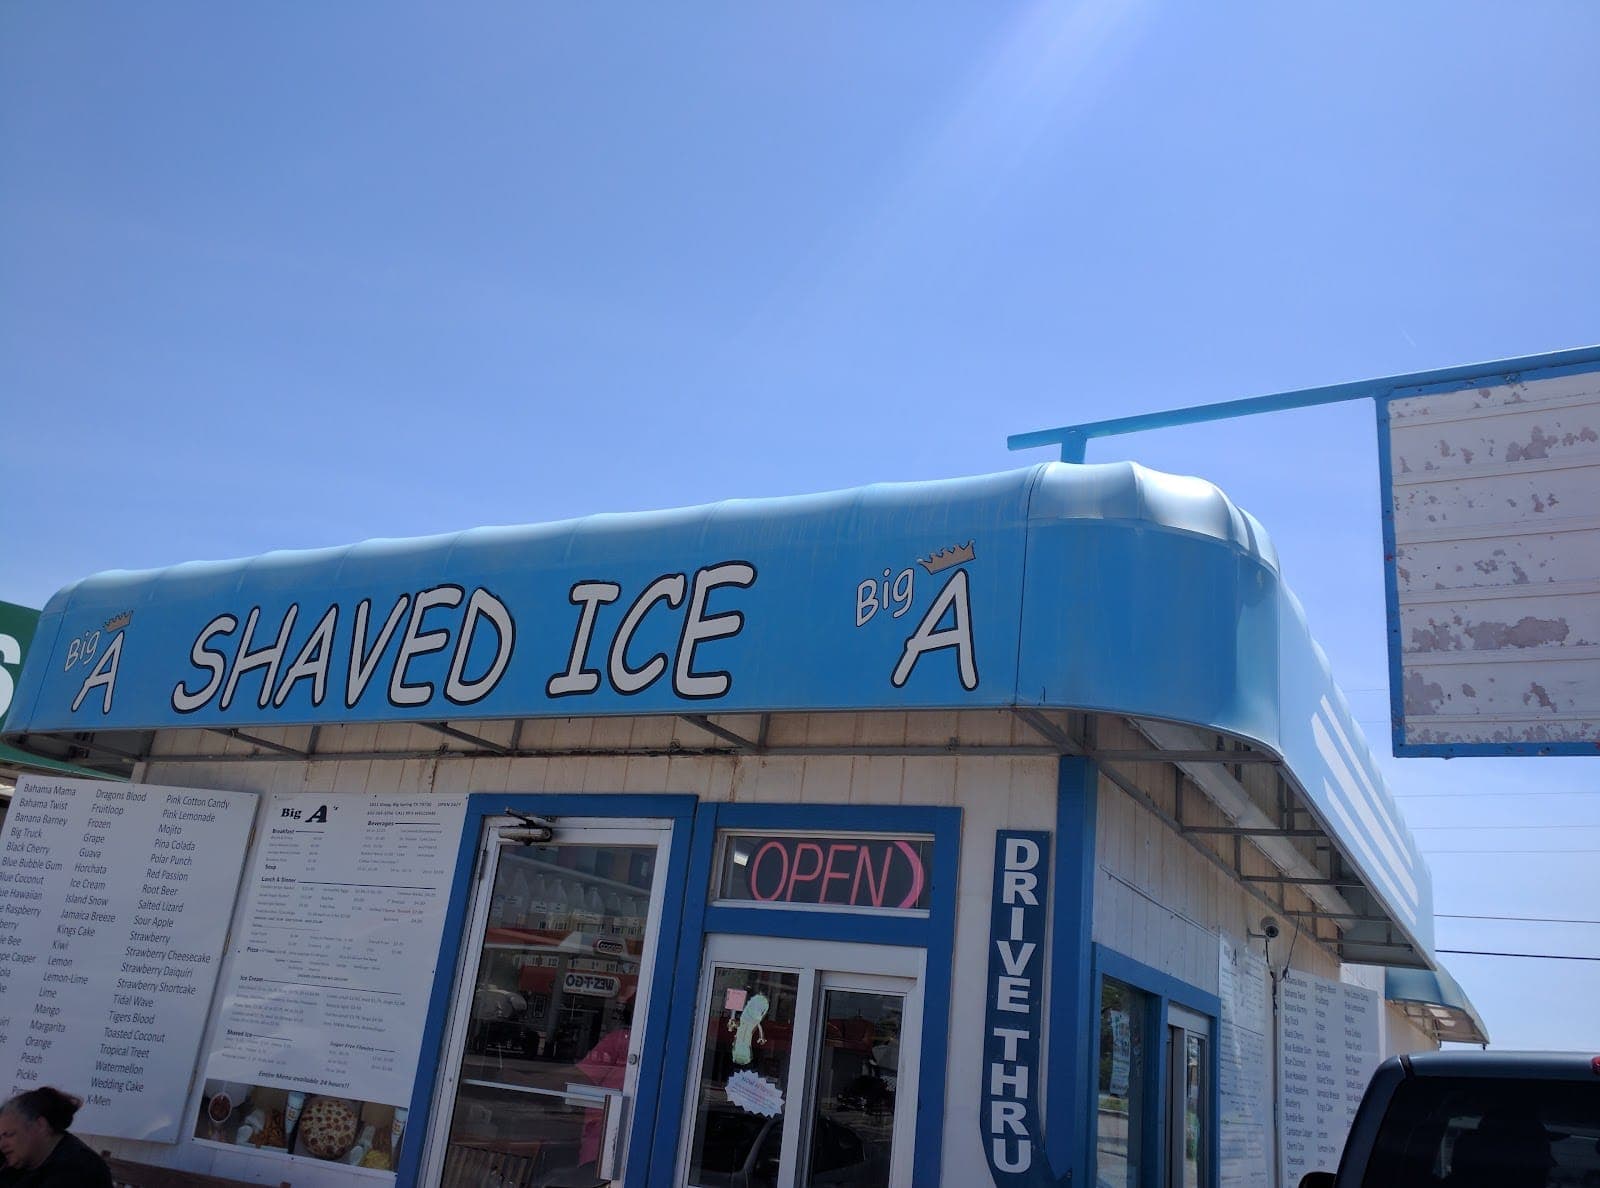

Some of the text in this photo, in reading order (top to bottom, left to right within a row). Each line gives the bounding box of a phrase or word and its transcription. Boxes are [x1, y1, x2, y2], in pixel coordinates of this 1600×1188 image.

[856, 567, 914, 626] Big
[890, 568, 978, 691] A
[171, 584, 516, 713] SHAVED
[546, 560, 757, 700] ICE
[63, 630, 98, 673] Big
[70, 631, 124, 714] A
[24, 784, 76, 796] Bahama Mama
[96, 789, 146, 802] Dragons Blood
[19, 798, 68, 810] Bahama Twist
[166, 794, 230, 810] Pink Cotton Candy
[15, 812, 68, 826] Banana Barney
[162, 810, 216, 822] Pink Lemonade
[281, 808, 302, 820] Big
[305, 804, 328, 823] A
[88, 818, 111, 828] Frozen
[10, 828, 42, 838] Big Truck
[158, 824, 182, 836] Mojito
[84, 833, 104, 844] Grape
[155, 839, 196, 851] Pina Colada
[6, 842, 50, 856] Black Cherry
[80, 848, 101, 858] Guava
[2, 857, 62, 871] Blue Bubble Gum
[150, 854, 192, 866] Polar Punch
[75, 863, 106, 874] Horchata
[146, 868, 188, 881] Red Passion
[751, 840, 894, 908] OPEN
[13, 874, 44, 885] Coconut
[70, 878, 105, 890] Ice Cream
[142, 884, 178, 896] Root Beer
[66, 894, 108, 906] Island Snow
[138, 900, 184, 912] Salted Lizard
[6, 904, 41, 917] Raspberry
[61, 909, 116, 922] Jamaica Breeze
[134, 916, 174, 928] Sour Apple
[57, 924, 96, 937] Kings Cake
[130, 931, 170, 944] Strawberry
[52, 940, 69, 950] Kiwi
[48, 956, 72, 966] Lemon
[125, 946, 210, 964] Strawberry Cheesecake
[121, 962, 162, 976] Strawberry
[38, 987, 56, 998] Lime
[117, 978, 196, 996] Strawberry Shortcake
[114, 994, 154, 1007] Tidal Wave
[990, 838, 1040, 1174] DRIVE THRU
[35, 1004, 60, 1016] Mango
[109, 1010, 155, 1024] Tigers Blood
[30, 1020, 66, 1034] Margarita
[104, 1028, 166, 1042] Toasted Coconut
[25, 1036, 52, 1049] Orange
[100, 1044, 129, 1057] Tropical
[20, 1052, 43, 1064] Peach
[16, 1069, 38, 1082] Pickle
[91, 1077, 144, 1092] Wedding Cake
